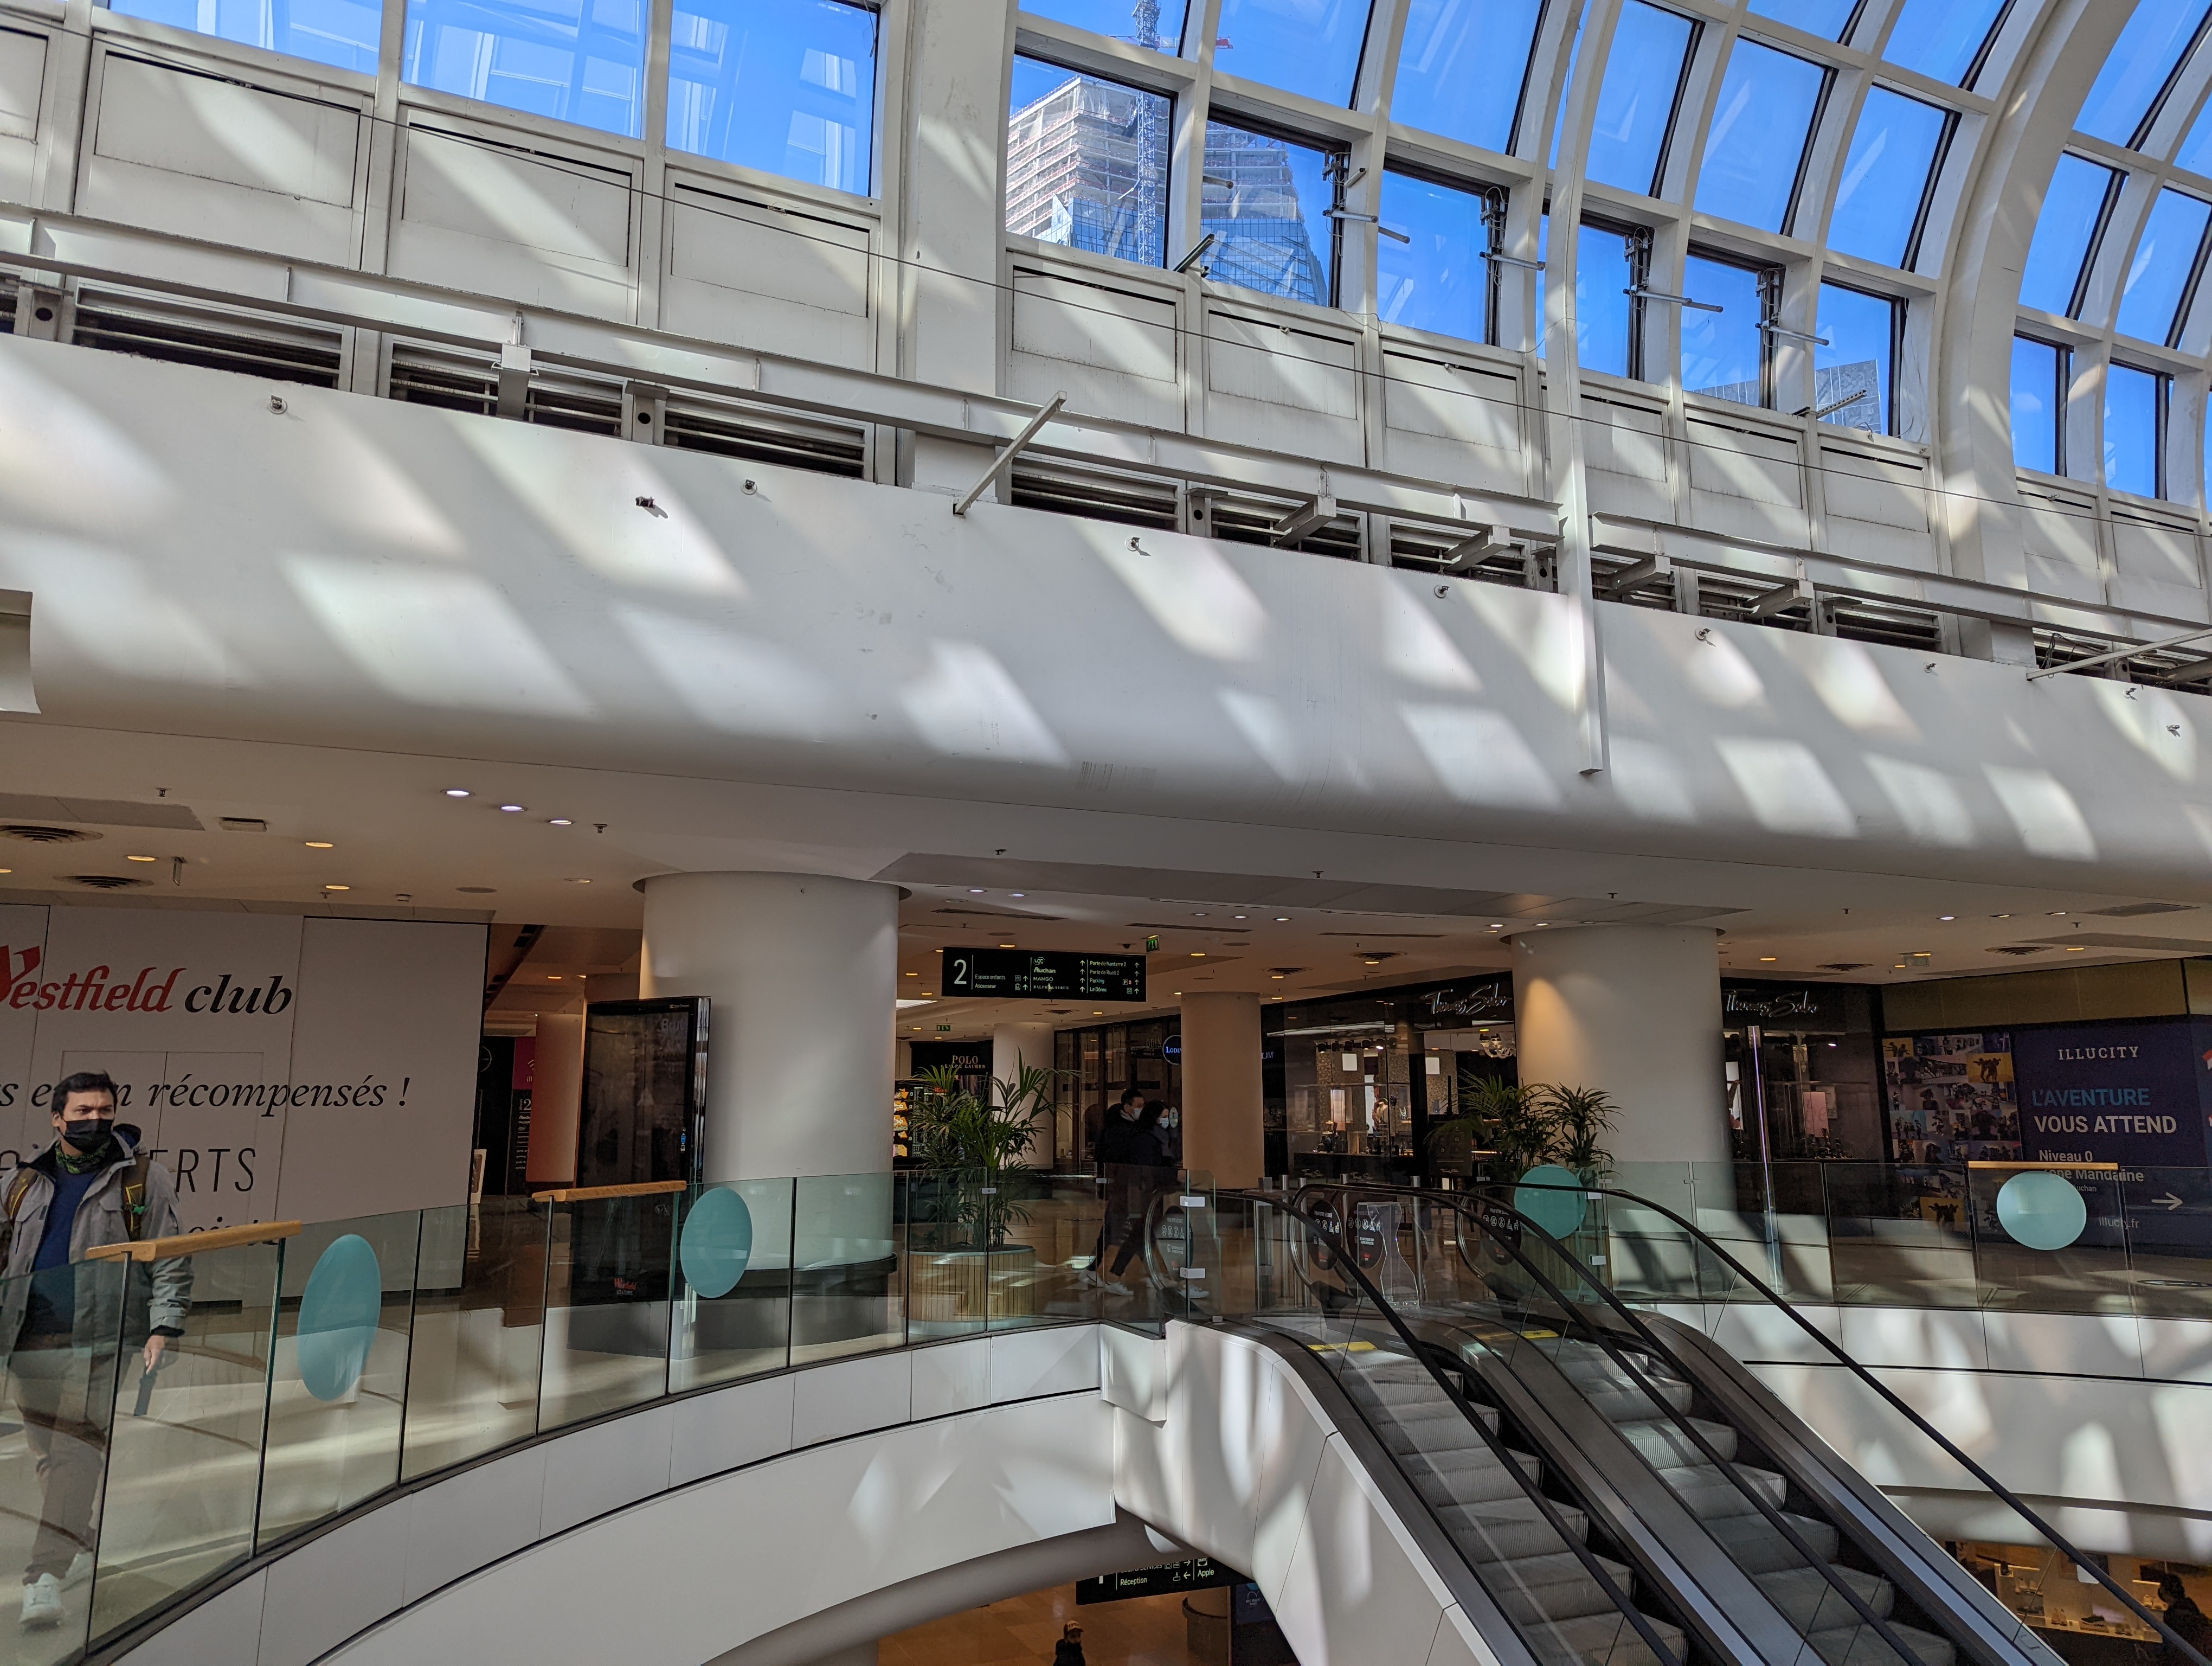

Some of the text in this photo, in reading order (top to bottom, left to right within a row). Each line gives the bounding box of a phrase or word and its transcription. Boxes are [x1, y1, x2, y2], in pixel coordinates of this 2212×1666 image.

[954, 959, 967, 984] 2
[185, 974, 293, 1014] club
[952, 1055, 979, 1065] POLO
[2059, 1046, 2139, 1060] ILLUCITY
[149, 1075, 388, 1117] récompensés
[398, 1077, 410, 1107] !
[2033, 1088, 2151, 1107] L'AVENTURE
[523, 1099, 531, 1111] 2
[2034, 1115, 2177, 1133] VOUS ATTEND
[2039, 1150, 2093, 1162] Niveau 0
[1197, 1568, 1214, 1578] Apple
[1120, 1577, 1147, 1586] Réception
